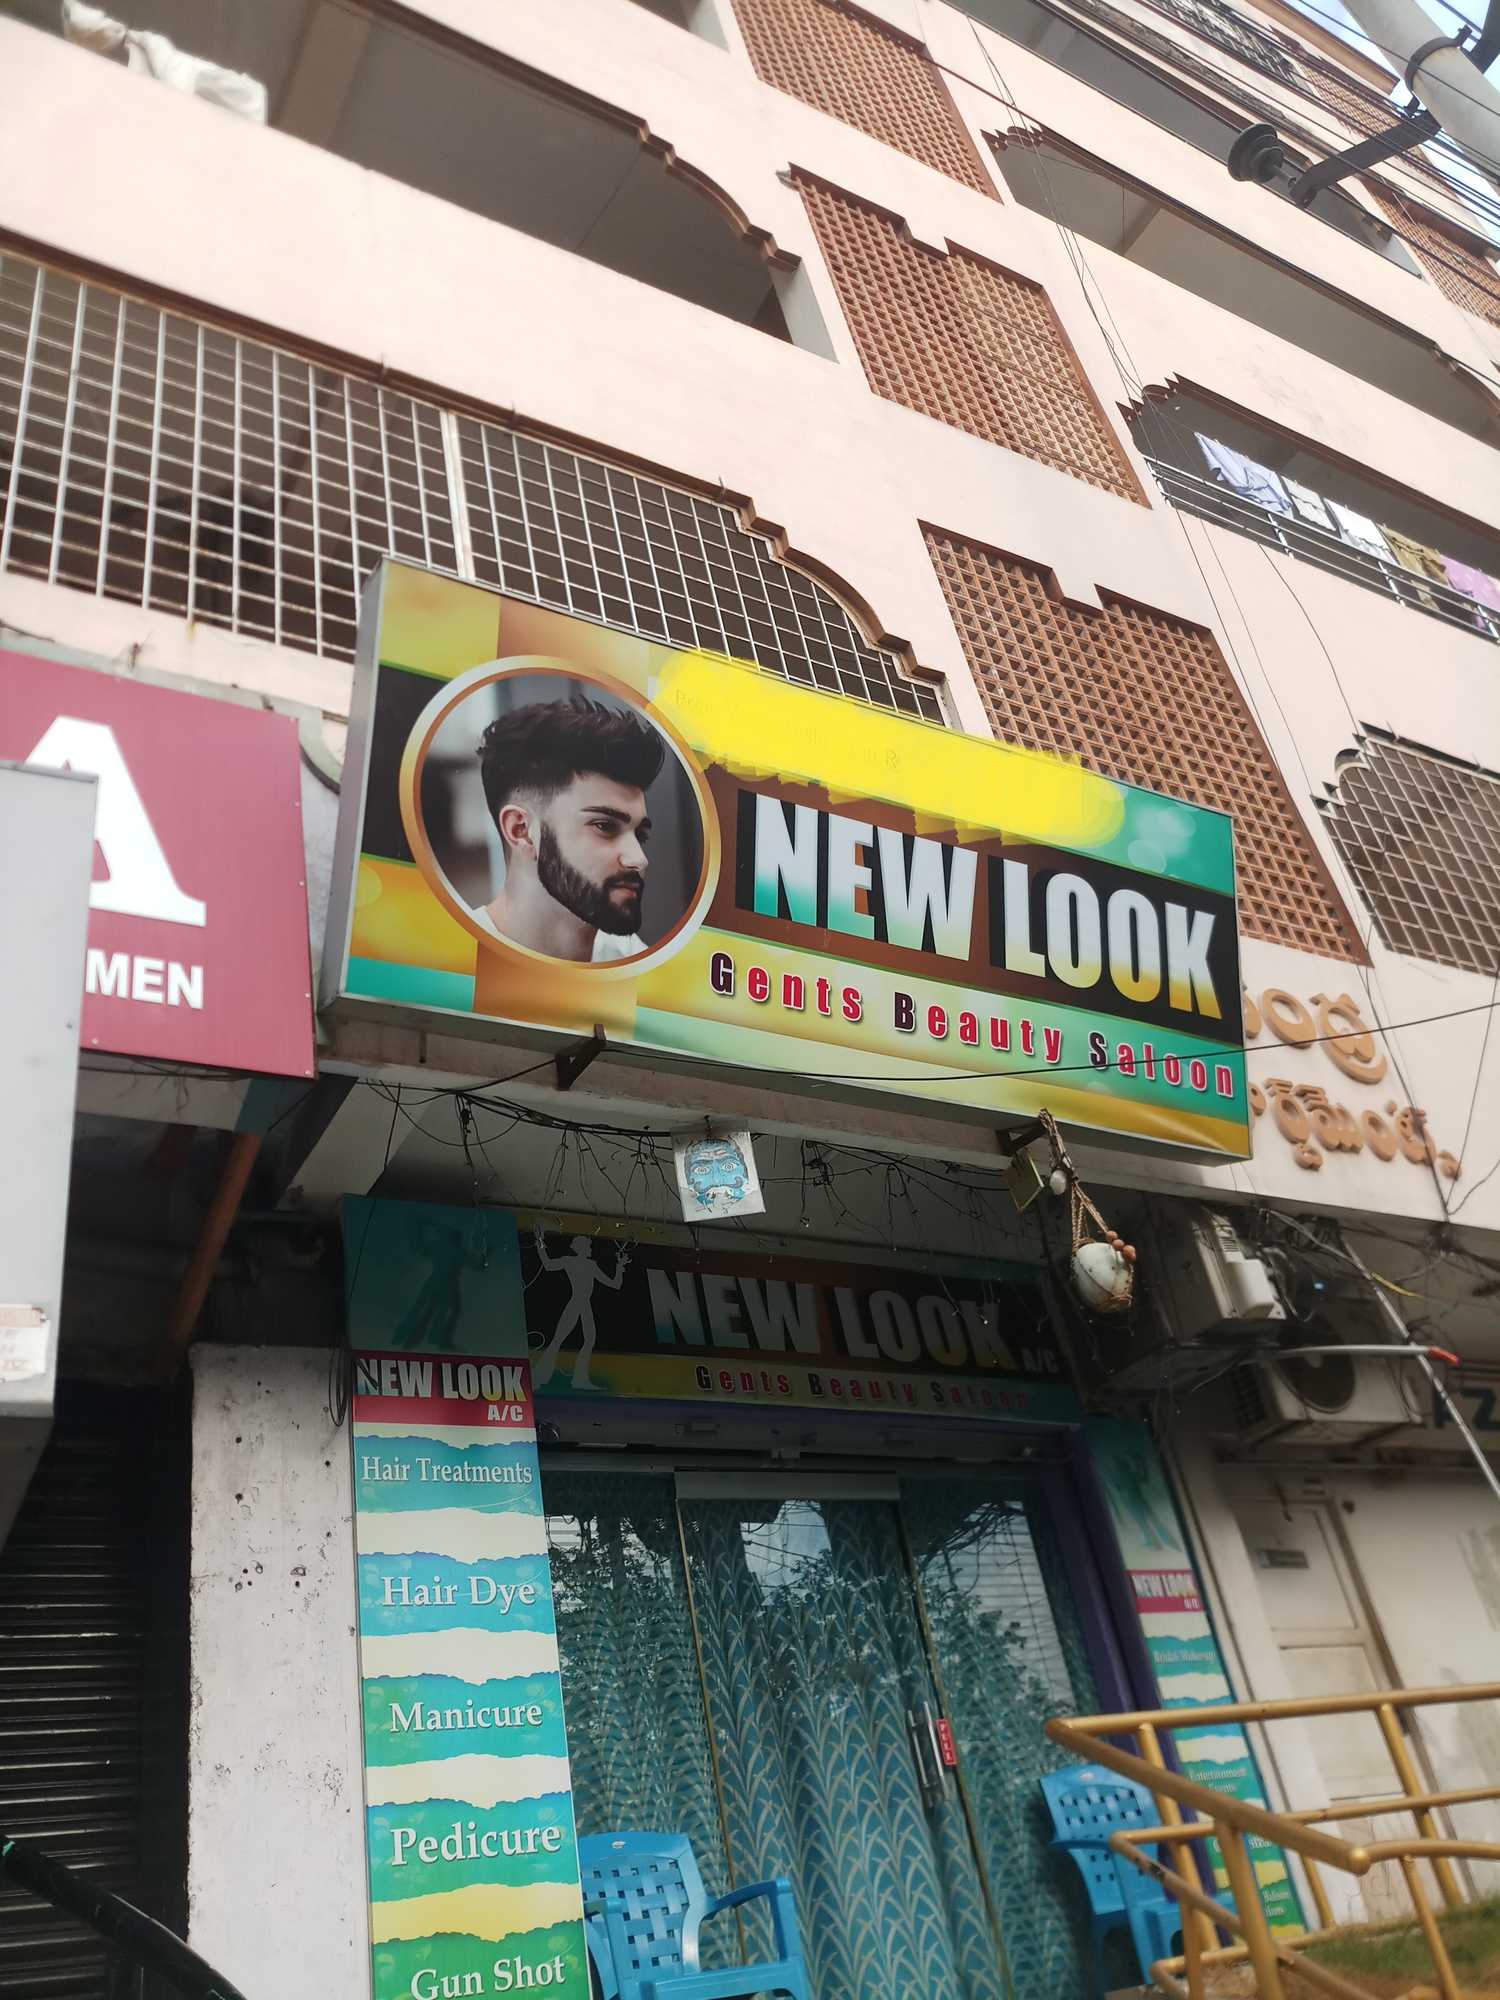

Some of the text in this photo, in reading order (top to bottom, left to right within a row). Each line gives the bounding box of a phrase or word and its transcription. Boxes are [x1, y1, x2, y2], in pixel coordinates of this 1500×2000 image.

[754, 793, 1223, 1020] NEW LOOK
[710, 951, 1235, 1098] Gents Beauty Saloon
[646, 1267, 821, 1355] NEW
[833, 1286, 1018, 1370] LOOK
[356, 1358, 528, 1403] NEW LOOK
[696, 1365, 791, 1395] Gents
[808, 1372, 914, 1405] Beauty
[487, 1404, 524, 1423] A/C
[361, 1455, 534, 1485] Hair Treatments
[381, 1574, 537, 1616] Hair Dye
[388, 1698, 544, 1734] Manicure
[390, 1820, 563, 1868] Pedicure
[410, 1953, 566, 2000] Gun Shot
